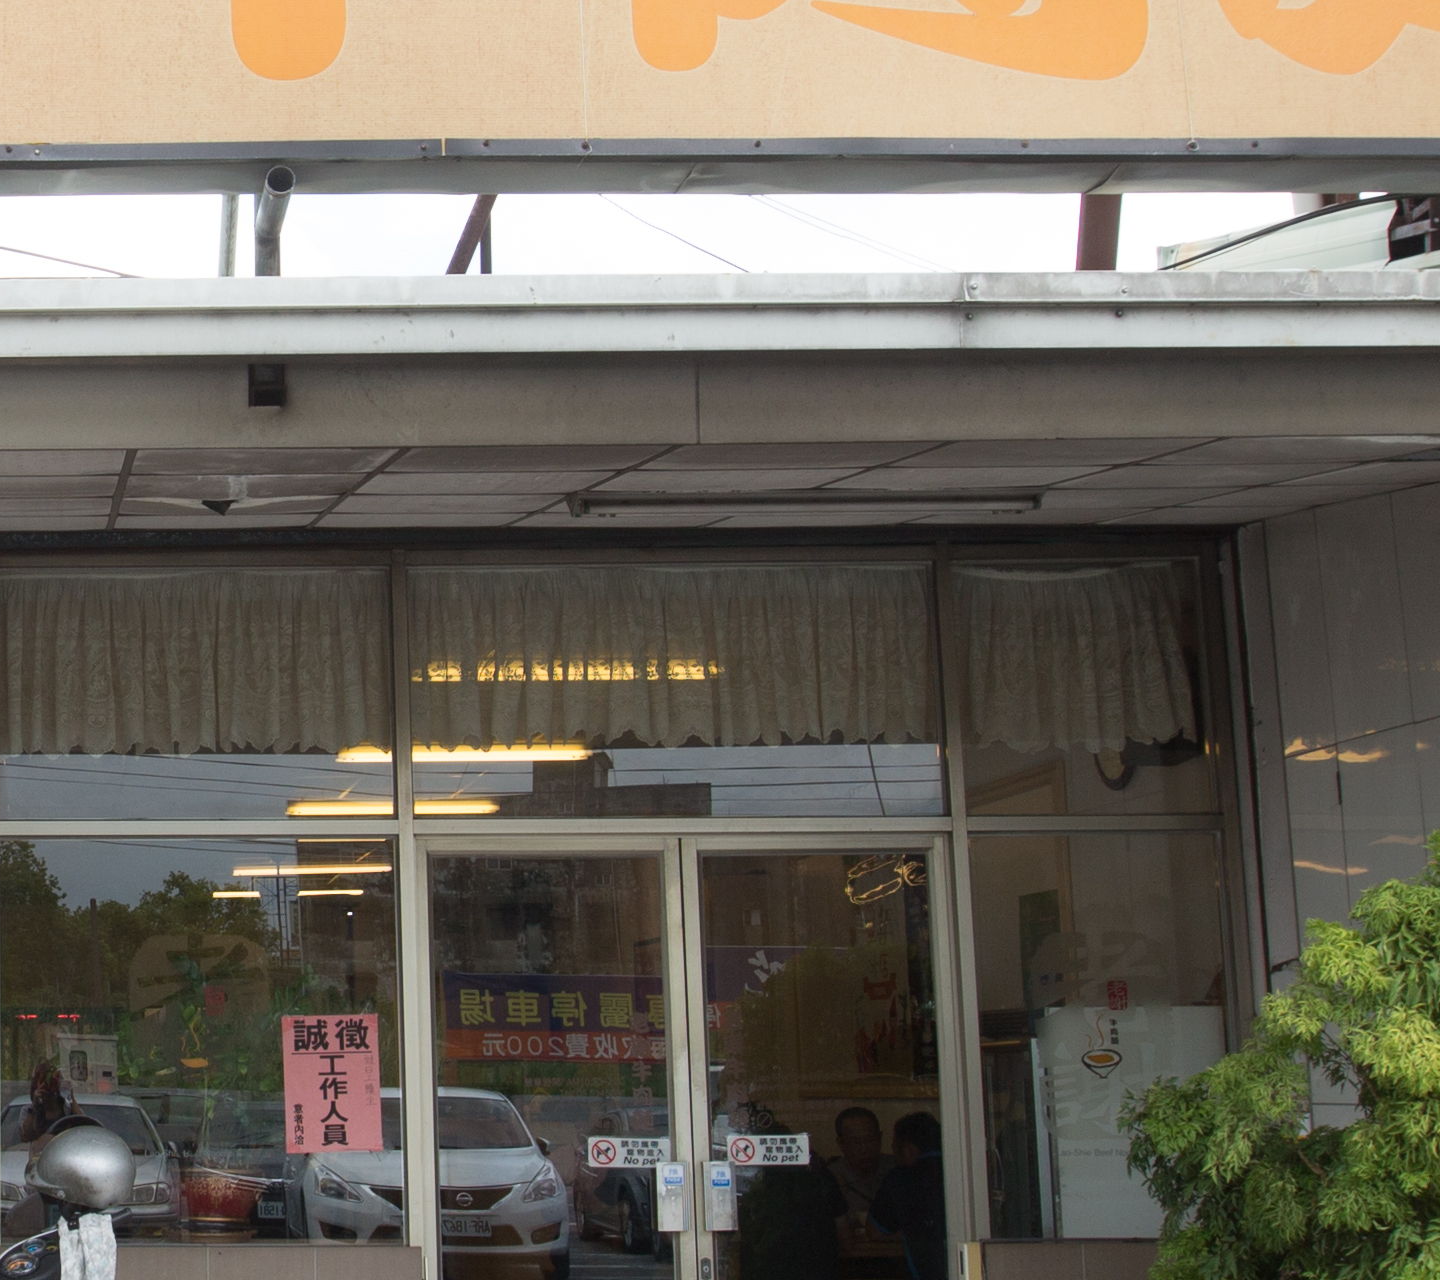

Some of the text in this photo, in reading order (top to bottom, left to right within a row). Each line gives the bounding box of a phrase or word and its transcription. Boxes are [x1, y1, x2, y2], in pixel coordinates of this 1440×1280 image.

[293, 1019, 370, 1051] 誠徵
[318, 1054, 348, 1146] 工作人員
[623, 1156, 640, 1165] No
[762, 1153, 800, 1164] No pet
